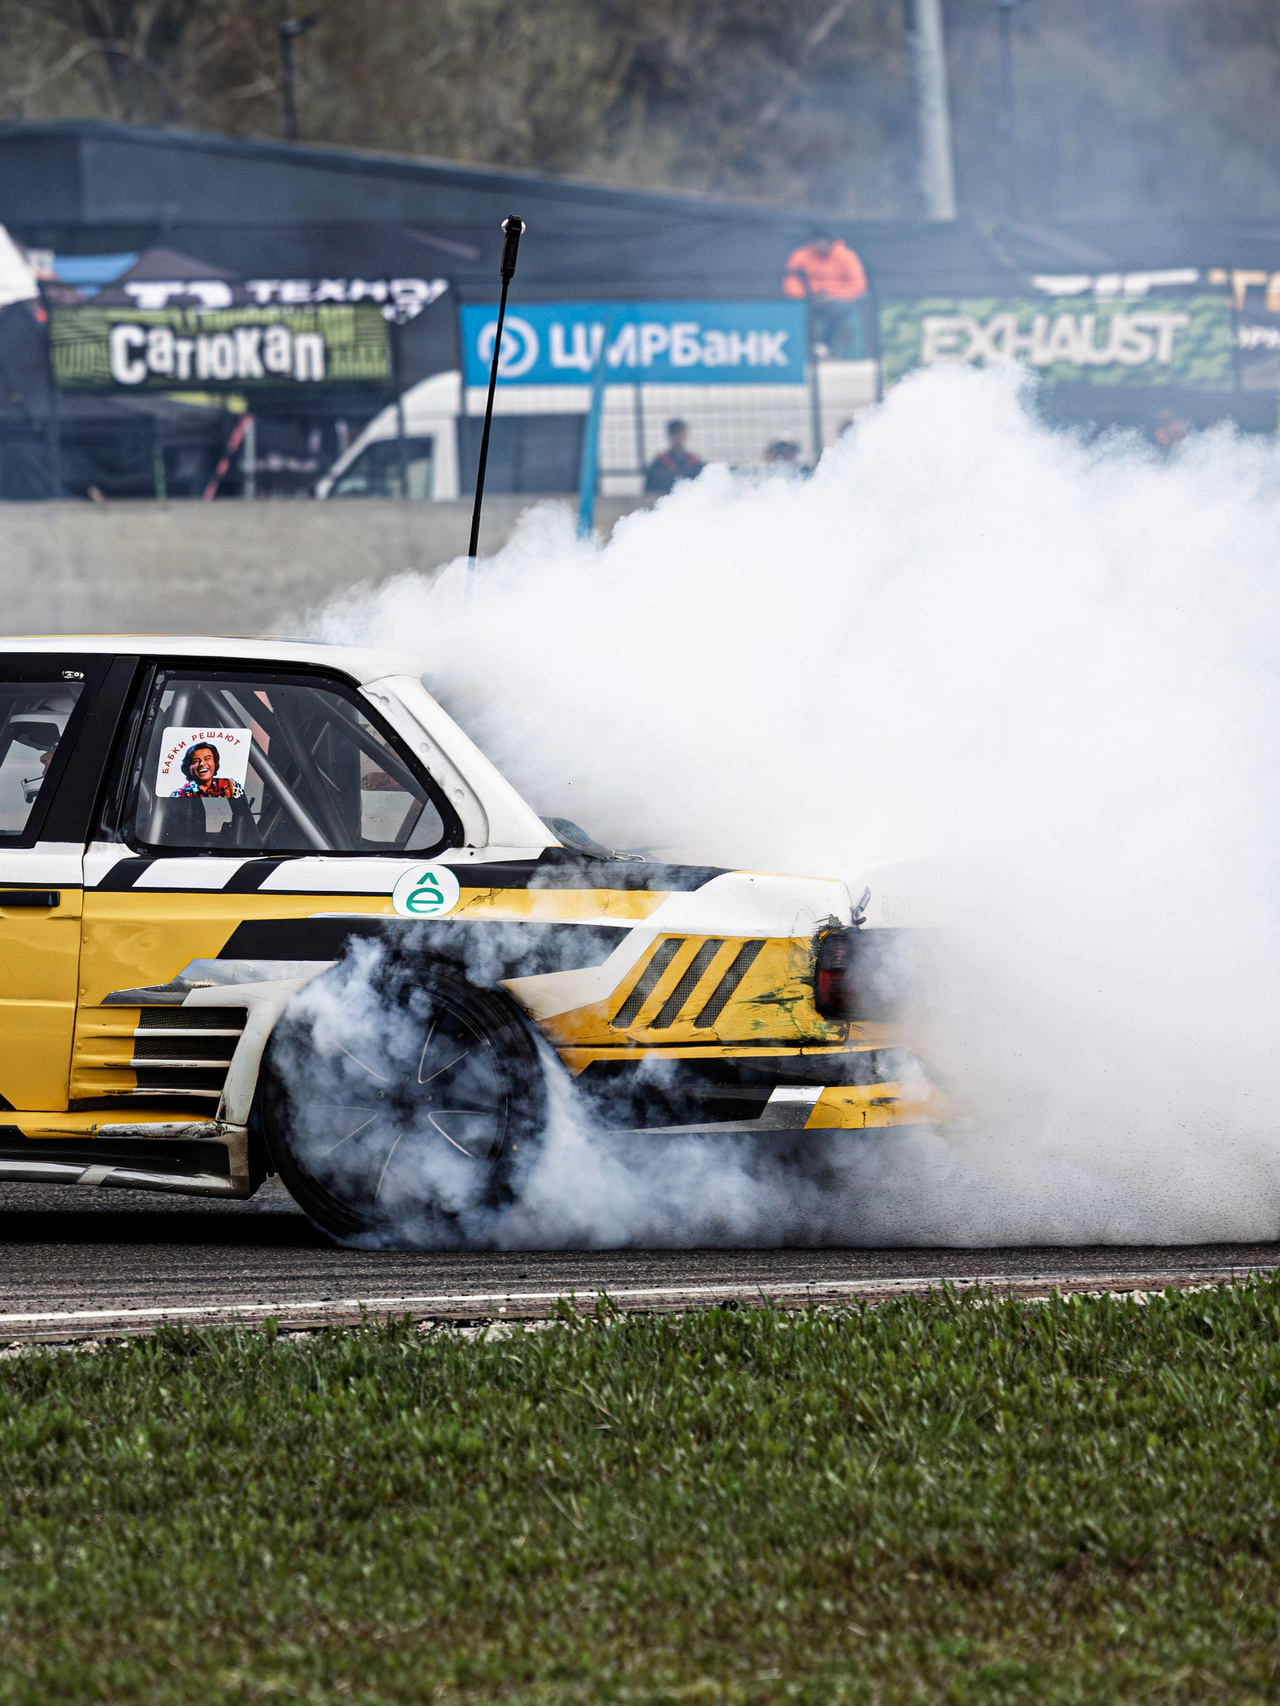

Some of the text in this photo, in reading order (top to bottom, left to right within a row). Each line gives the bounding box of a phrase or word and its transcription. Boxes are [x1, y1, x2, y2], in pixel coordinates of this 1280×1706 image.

[921, 311, 1190, 367] EXHAUST
[162, 731, 241, 774] БАБКИ РЕШАЮТ
